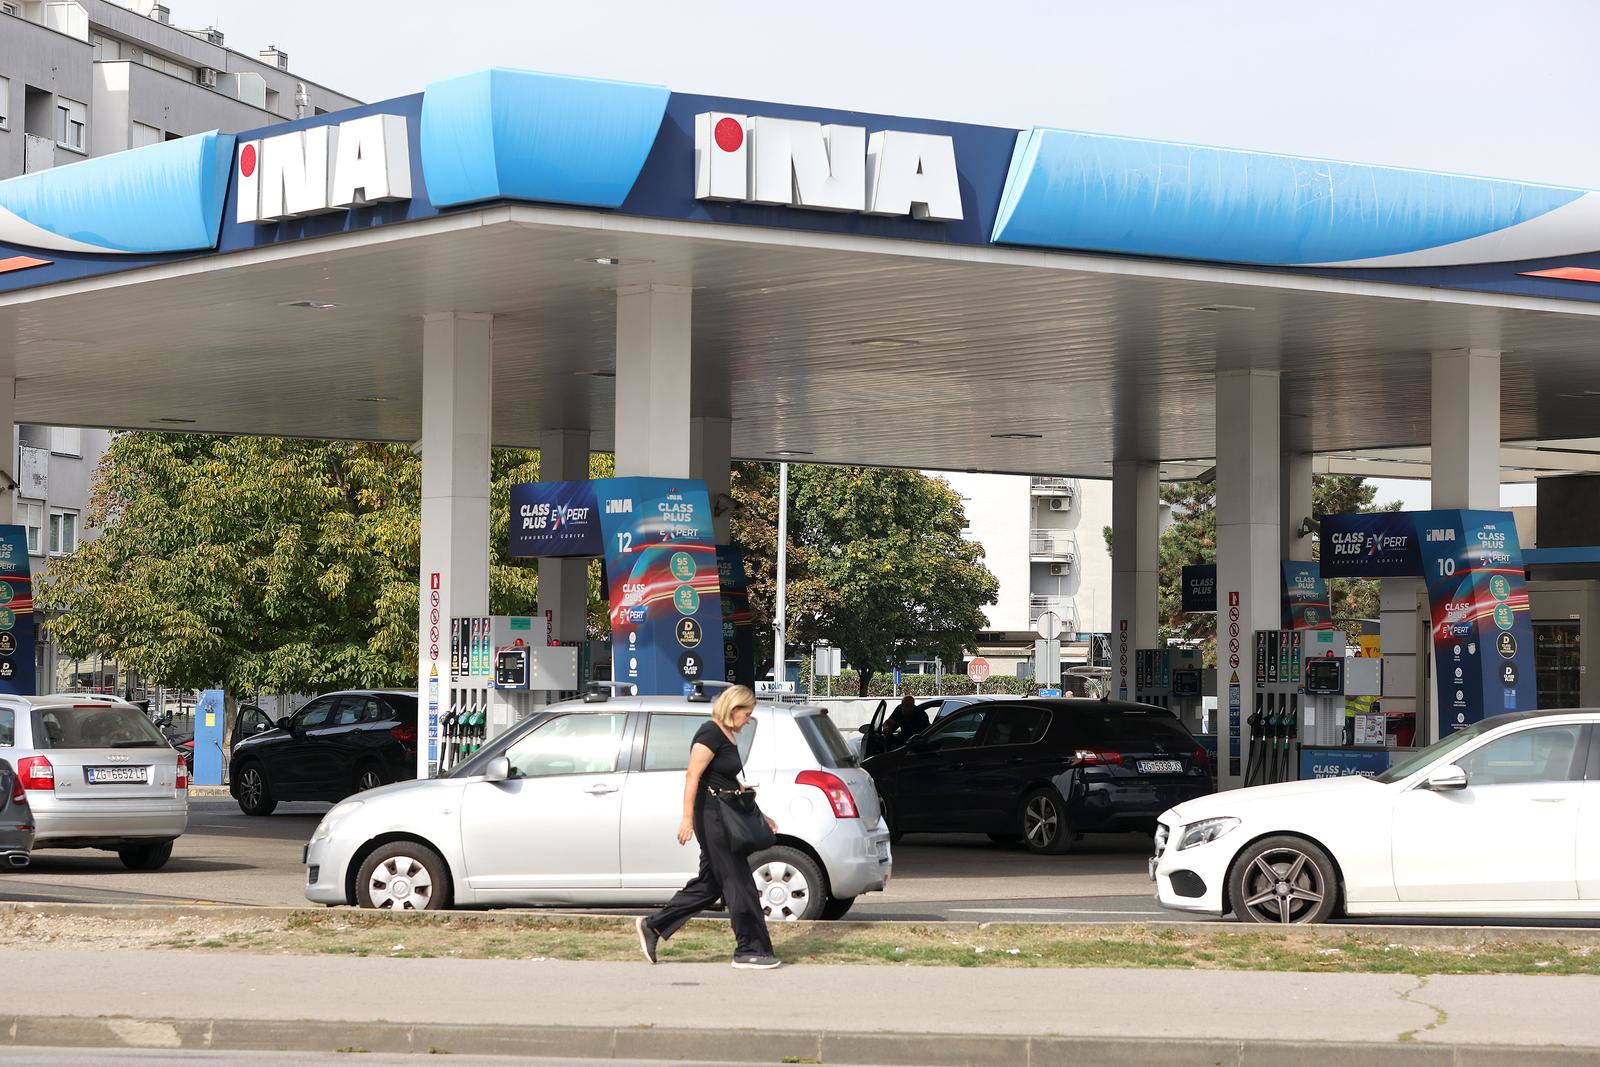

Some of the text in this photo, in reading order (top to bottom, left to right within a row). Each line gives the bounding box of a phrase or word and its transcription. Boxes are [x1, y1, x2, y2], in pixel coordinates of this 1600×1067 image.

[658, 502, 694, 513] CLASS
[520, 503, 589, 531] CLASS EXPERT
[663, 512, 692, 522] PLUS
[522, 516, 547, 529] PLUS
[1477, 531, 1505, 541] CLASS
[617, 532, 633, 553] 12
[1331, 532, 1408, 556] CLASS EXPERT
[1481, 540, 1504, 549] PLUS
[1335, 543, 1361, 555] PLUS
[677, 557, 688, 566] 95
[1437, 557, 1456, 576] 10
[1190, 578, 1214, 587] CLASS
[1494, 579, 1504, 587] 95
[622, 583, 646, 593] CLASS
[1192, 586, 1212, 595] PLUS
[680, 590, 692, 599] 95
[1444, 602, 1470, 611] CLASS
[619, 608, 645, 624] EXPERT
[1498, 608, 1508, 616] 95
[684, 621, 693, 631] D
[723, 622, 733, 630] 95
[1442, 624, 1470, 639] EXPERT
[1503, 636, 1510, 644] D
[2, 662, 10, 670] D
[686, 657, 695, 667] D
[970, 664, 987, 675] STOP
[1505, 666, 1512, 675] D
[1142, 761, 1153, 771] ZG
[1312, 764, 1340, 774] CLASS
[95, 767, 107, 780] ZG
